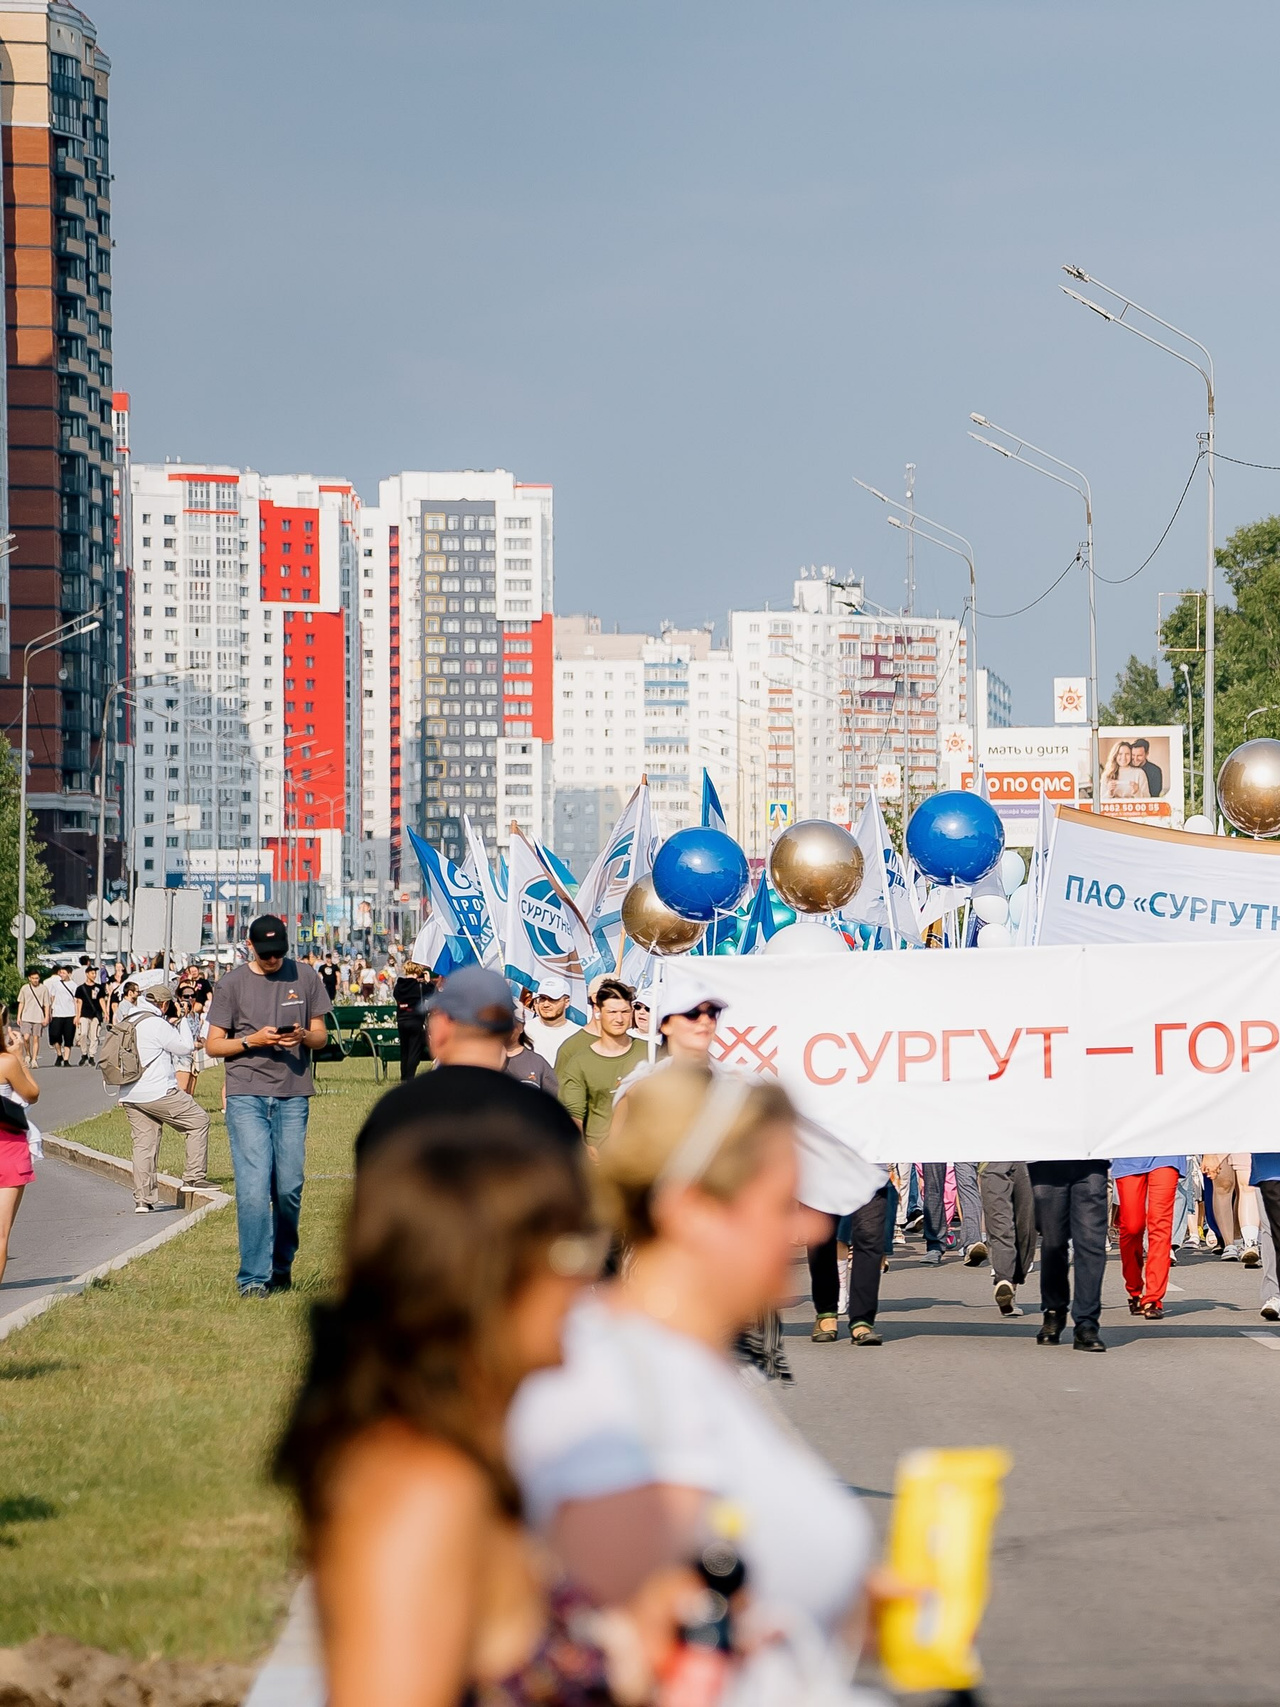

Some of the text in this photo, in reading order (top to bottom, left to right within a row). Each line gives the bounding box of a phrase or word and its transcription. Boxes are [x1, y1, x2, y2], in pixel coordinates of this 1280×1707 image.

[1002, 776, 1028, 793] ПО
[1031, 776, 1071, 793] ОМС
[1065, 875, 1126, 910] ПАО
[803, 1024, 1069, 1085] СУРГУТ
